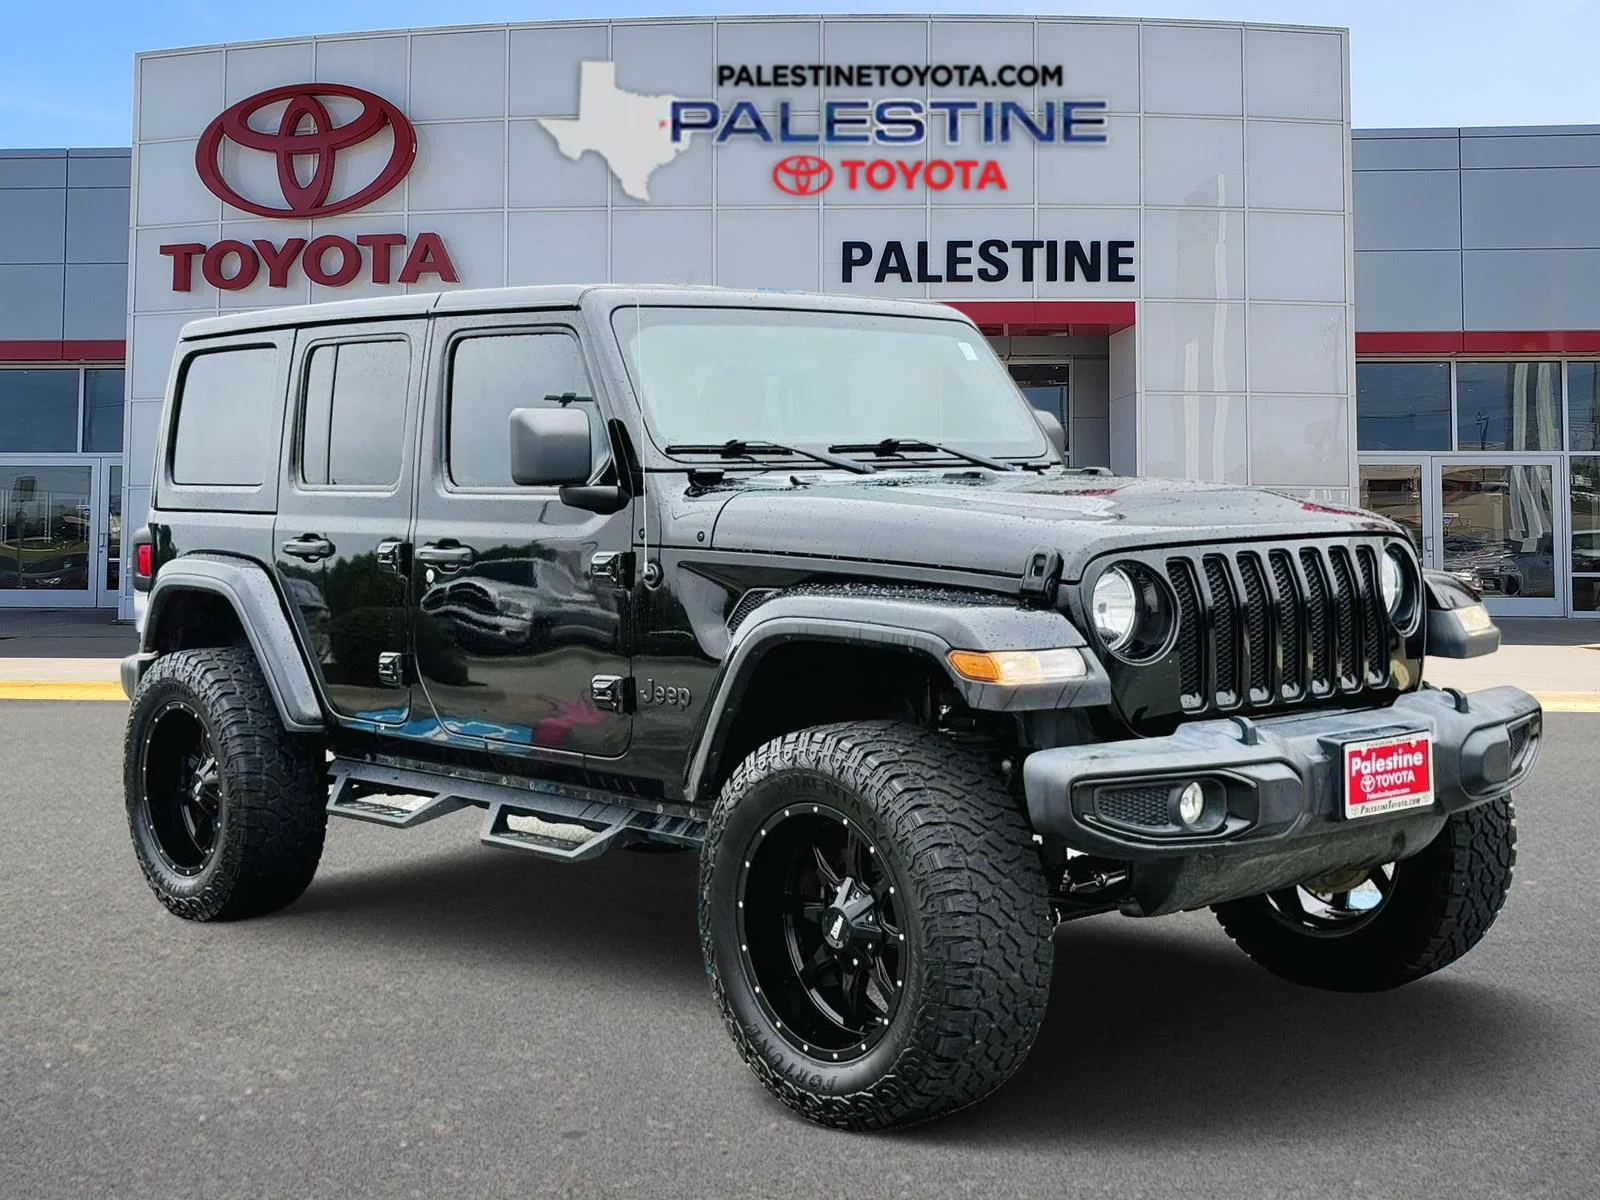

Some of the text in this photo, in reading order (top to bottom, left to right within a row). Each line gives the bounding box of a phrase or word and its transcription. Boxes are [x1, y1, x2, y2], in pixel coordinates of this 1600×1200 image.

[159, 232, 461, 292] TOYOTA
[841, 239, 1136, 283] PALESTINE
[640, 678, 692, 712] Jeep
[1351, 747, 1424, 777] Palestine
[1376, 770, 1416, 788] TOYOTA
